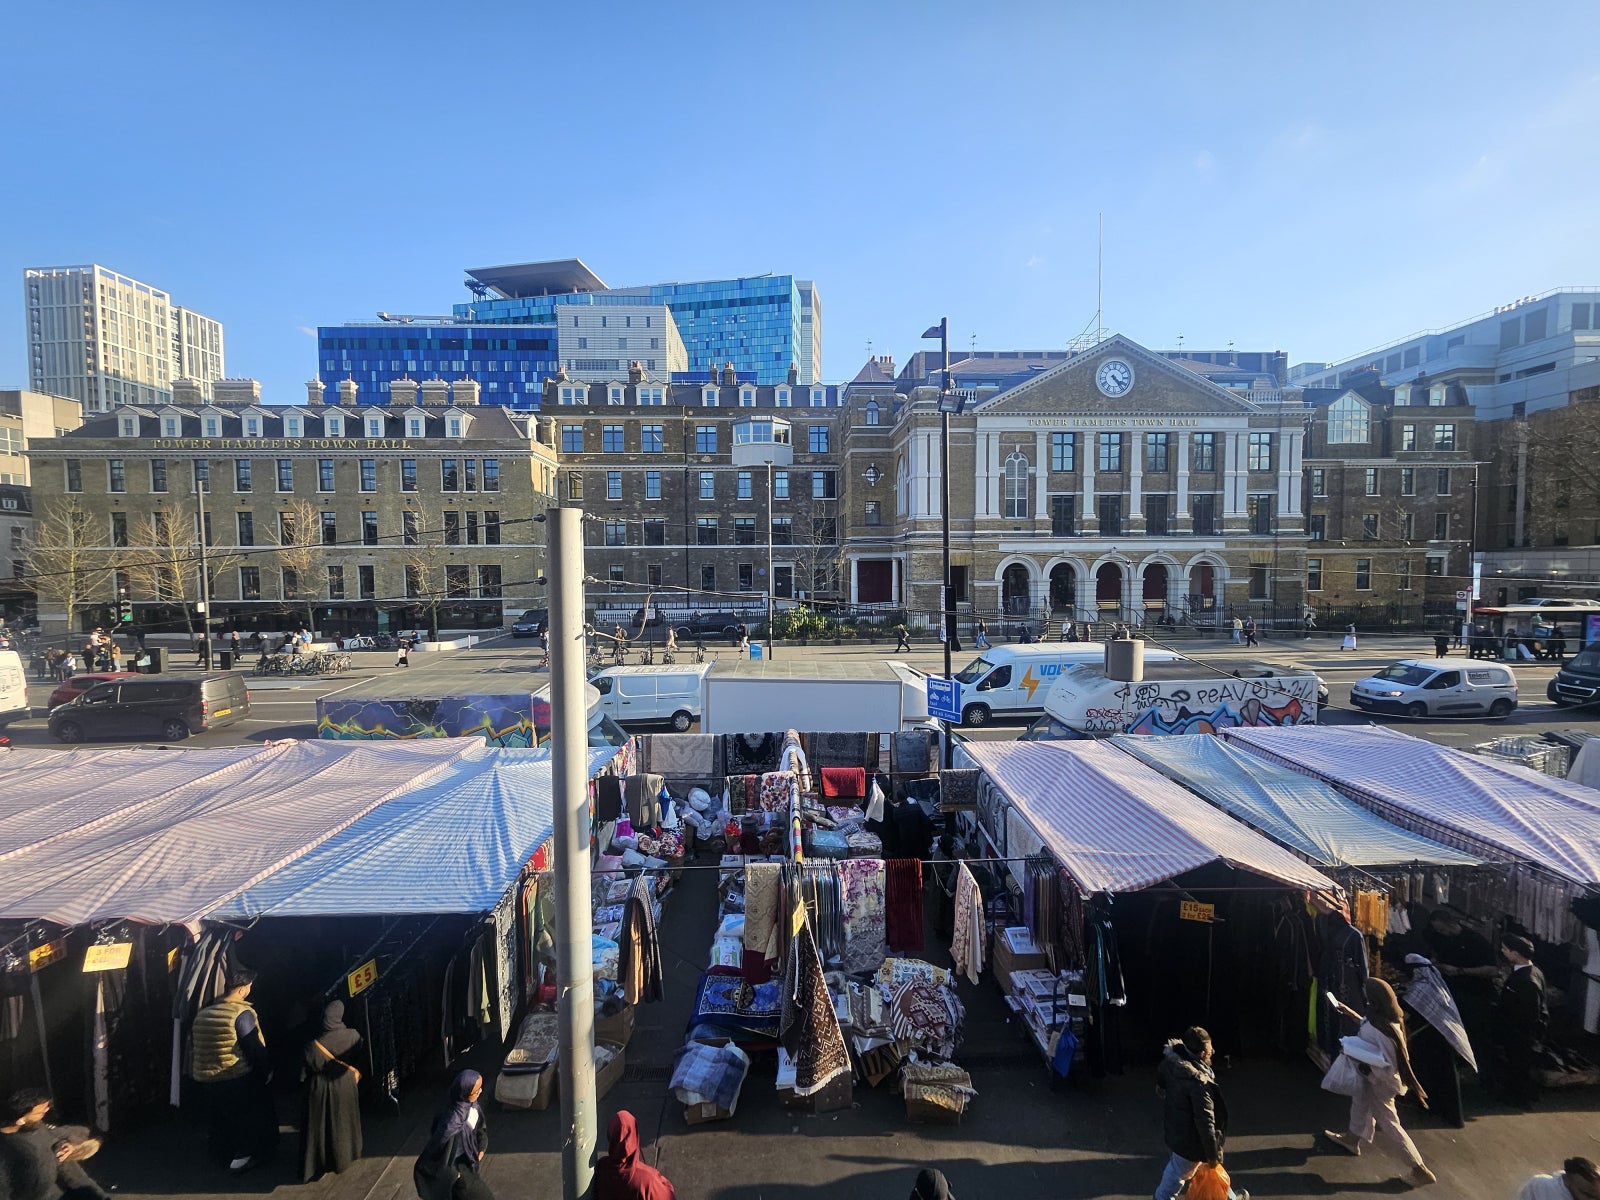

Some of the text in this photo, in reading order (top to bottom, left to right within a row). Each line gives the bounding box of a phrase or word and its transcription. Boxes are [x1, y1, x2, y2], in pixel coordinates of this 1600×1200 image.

[1028, 418, 1199, 427] TOWER HAMLETS TOWN HALL
[151, 438, 411, 450] TOWER HAMLETS TOWN HALL
[1183, 902, 1198, 912] £15
[354, 966, 372, 989] £5
